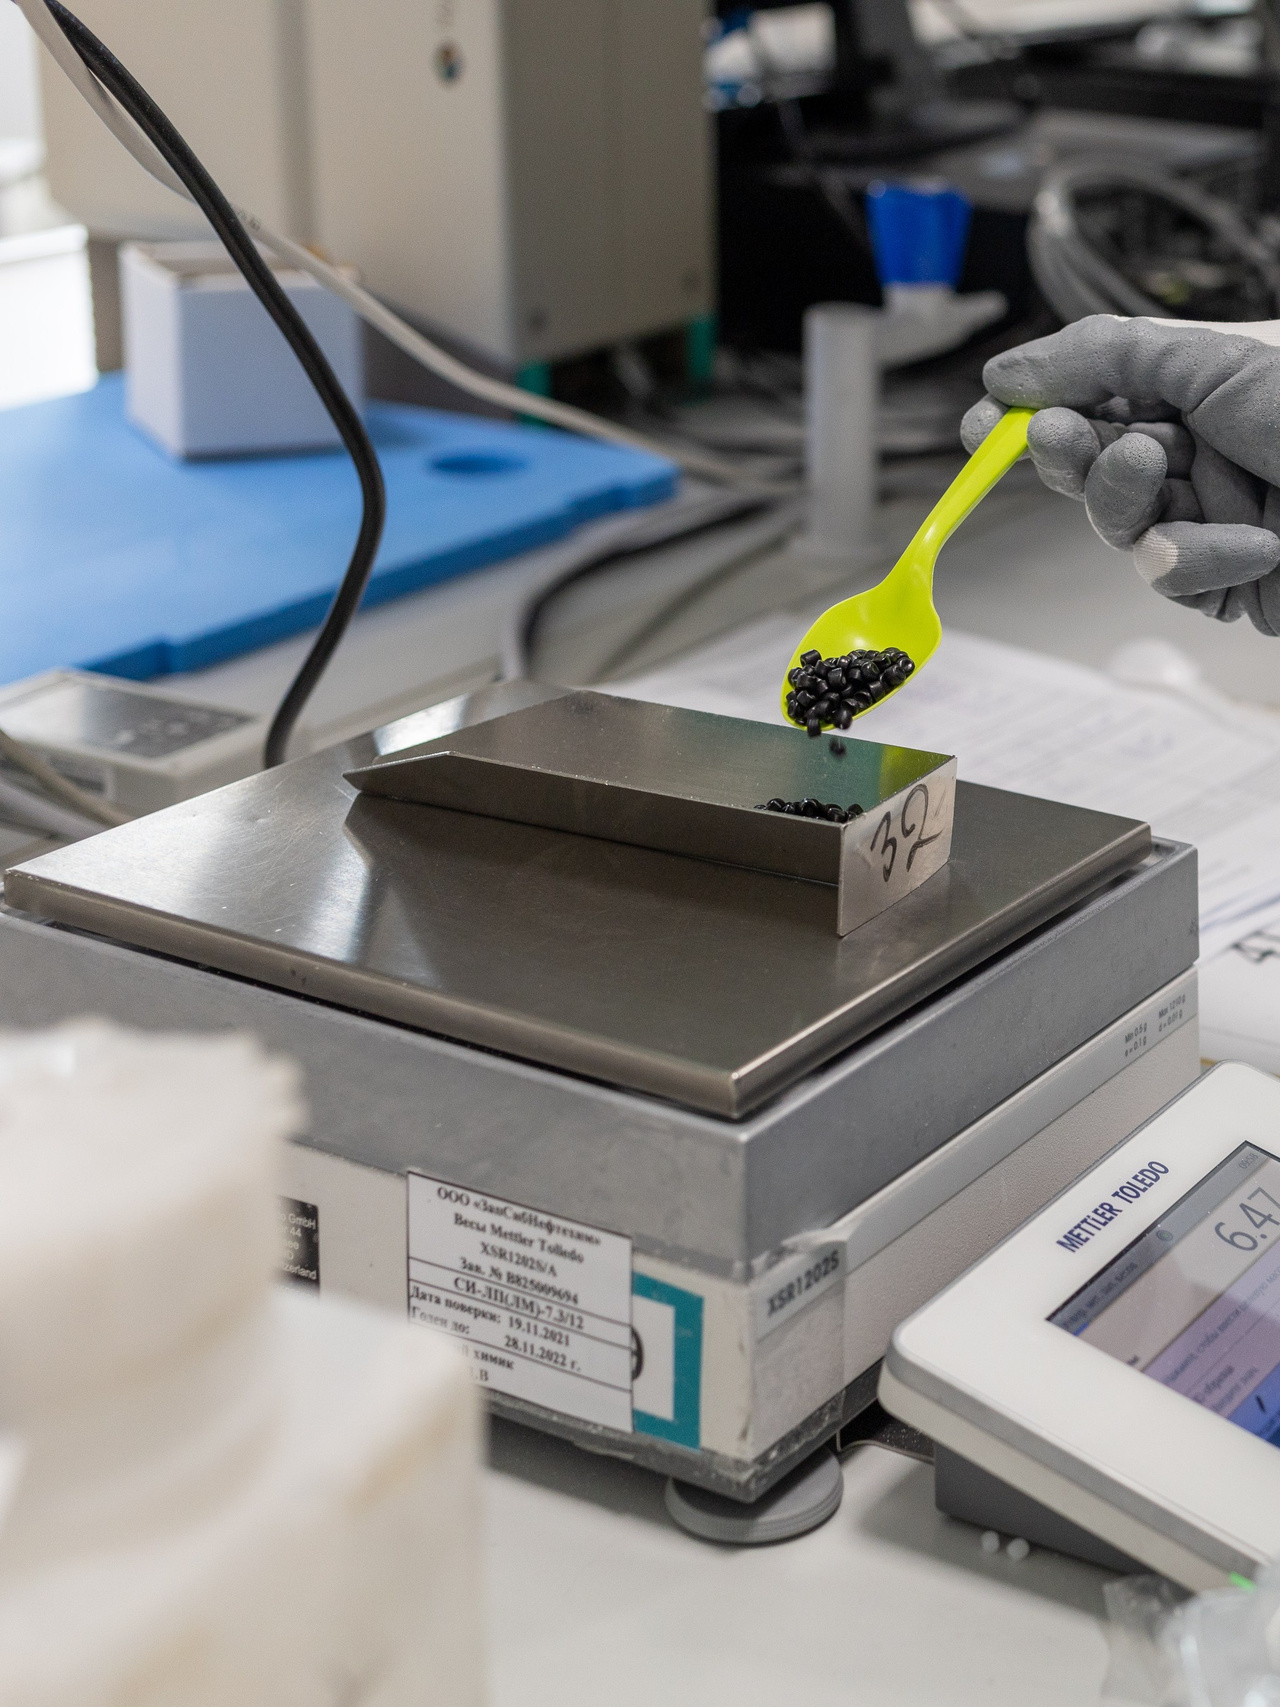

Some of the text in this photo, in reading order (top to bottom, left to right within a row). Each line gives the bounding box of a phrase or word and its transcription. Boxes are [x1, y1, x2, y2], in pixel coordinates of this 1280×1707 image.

[870, 784, 943, 882] 32
[1238, 1153, 1259, 1170] 09:58
[437, 1186, 471, 1207] ООО
[1056, 1160, 1170, 1253] METTLER TOLEDO
[454, 1213, 487, 1233] Весы
[490, 1223, 534, 1248] Mettler
[460, 1256, 485, 1276] Зав.
[488, 1265, 503, 1280] №
[480, 1241, 558, 1277] XSR1202S/A
[767, 1249, 839, 1318] XSR1202S
[410, 1286, 570, 1347] Дата поверки: 19.11.2021
[411, 1306, 448, 1328] Годен
[504, 1334, 567, 1367] 28.11.2022
[570, 1359, 581, 1372] г.
[473, 1350, 515, 1370] химик
